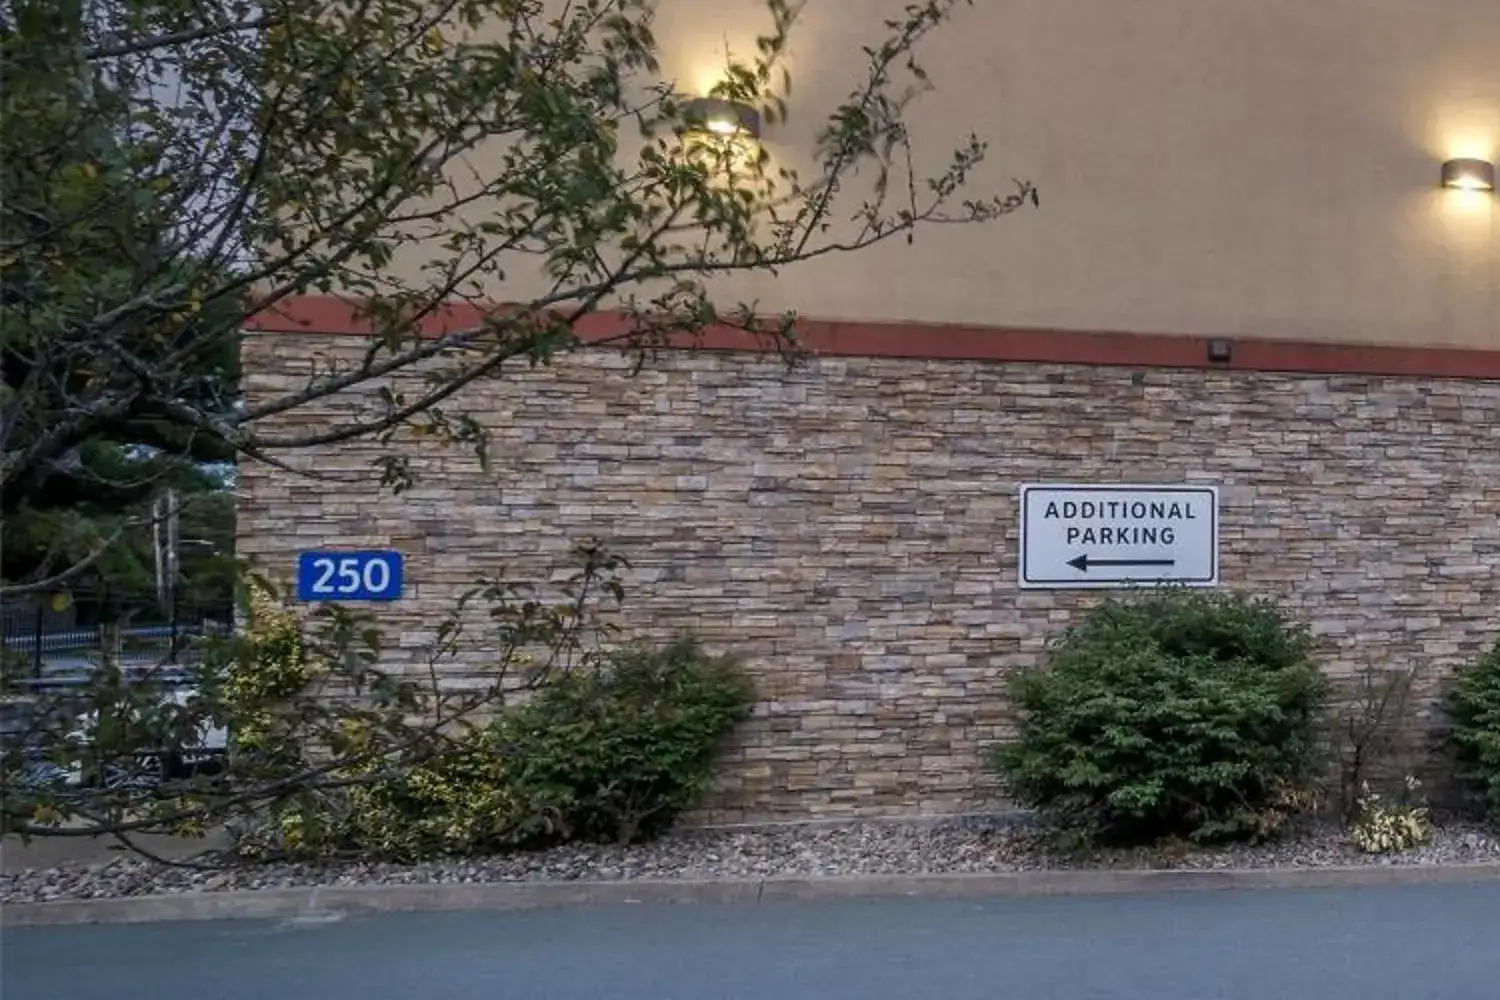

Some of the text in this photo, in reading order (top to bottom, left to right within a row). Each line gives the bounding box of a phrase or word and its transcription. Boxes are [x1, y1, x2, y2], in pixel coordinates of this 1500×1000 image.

[1044, 501, 1196, 519] ADDITIONAL
[1067, 527, 1175, 544] PARKING
[312, 558, 391, 593] 250
